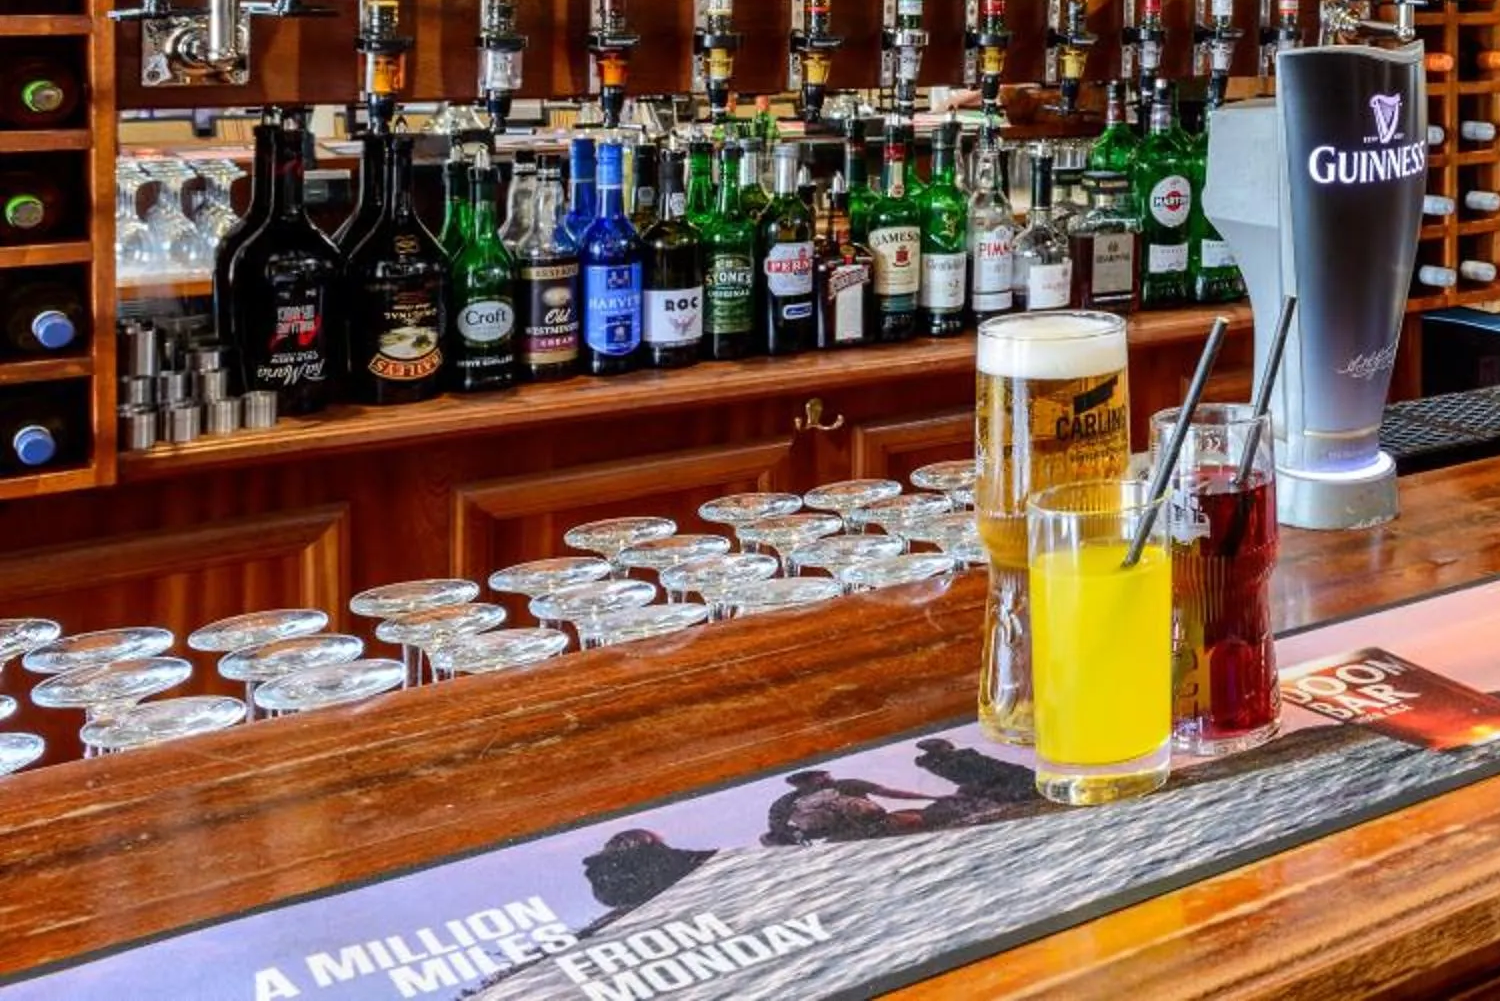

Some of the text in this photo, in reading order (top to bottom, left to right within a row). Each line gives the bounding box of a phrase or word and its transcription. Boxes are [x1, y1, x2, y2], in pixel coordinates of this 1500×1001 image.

[1308, 141, 1426, 184] GUINNESS
[465, 309, 507, 326] Croft
[544, 307, 572, 324] Old
[1055, 403, 1126, 441] CARLIN
[1306, 683, 1422, 721] BAR
[252, 896, 560, 1001] A MILLION
[389, 923, 581, 999] MILES
[555, 912, 736, 984] FROM
[583, 916, 834, 1001] MONDAY
